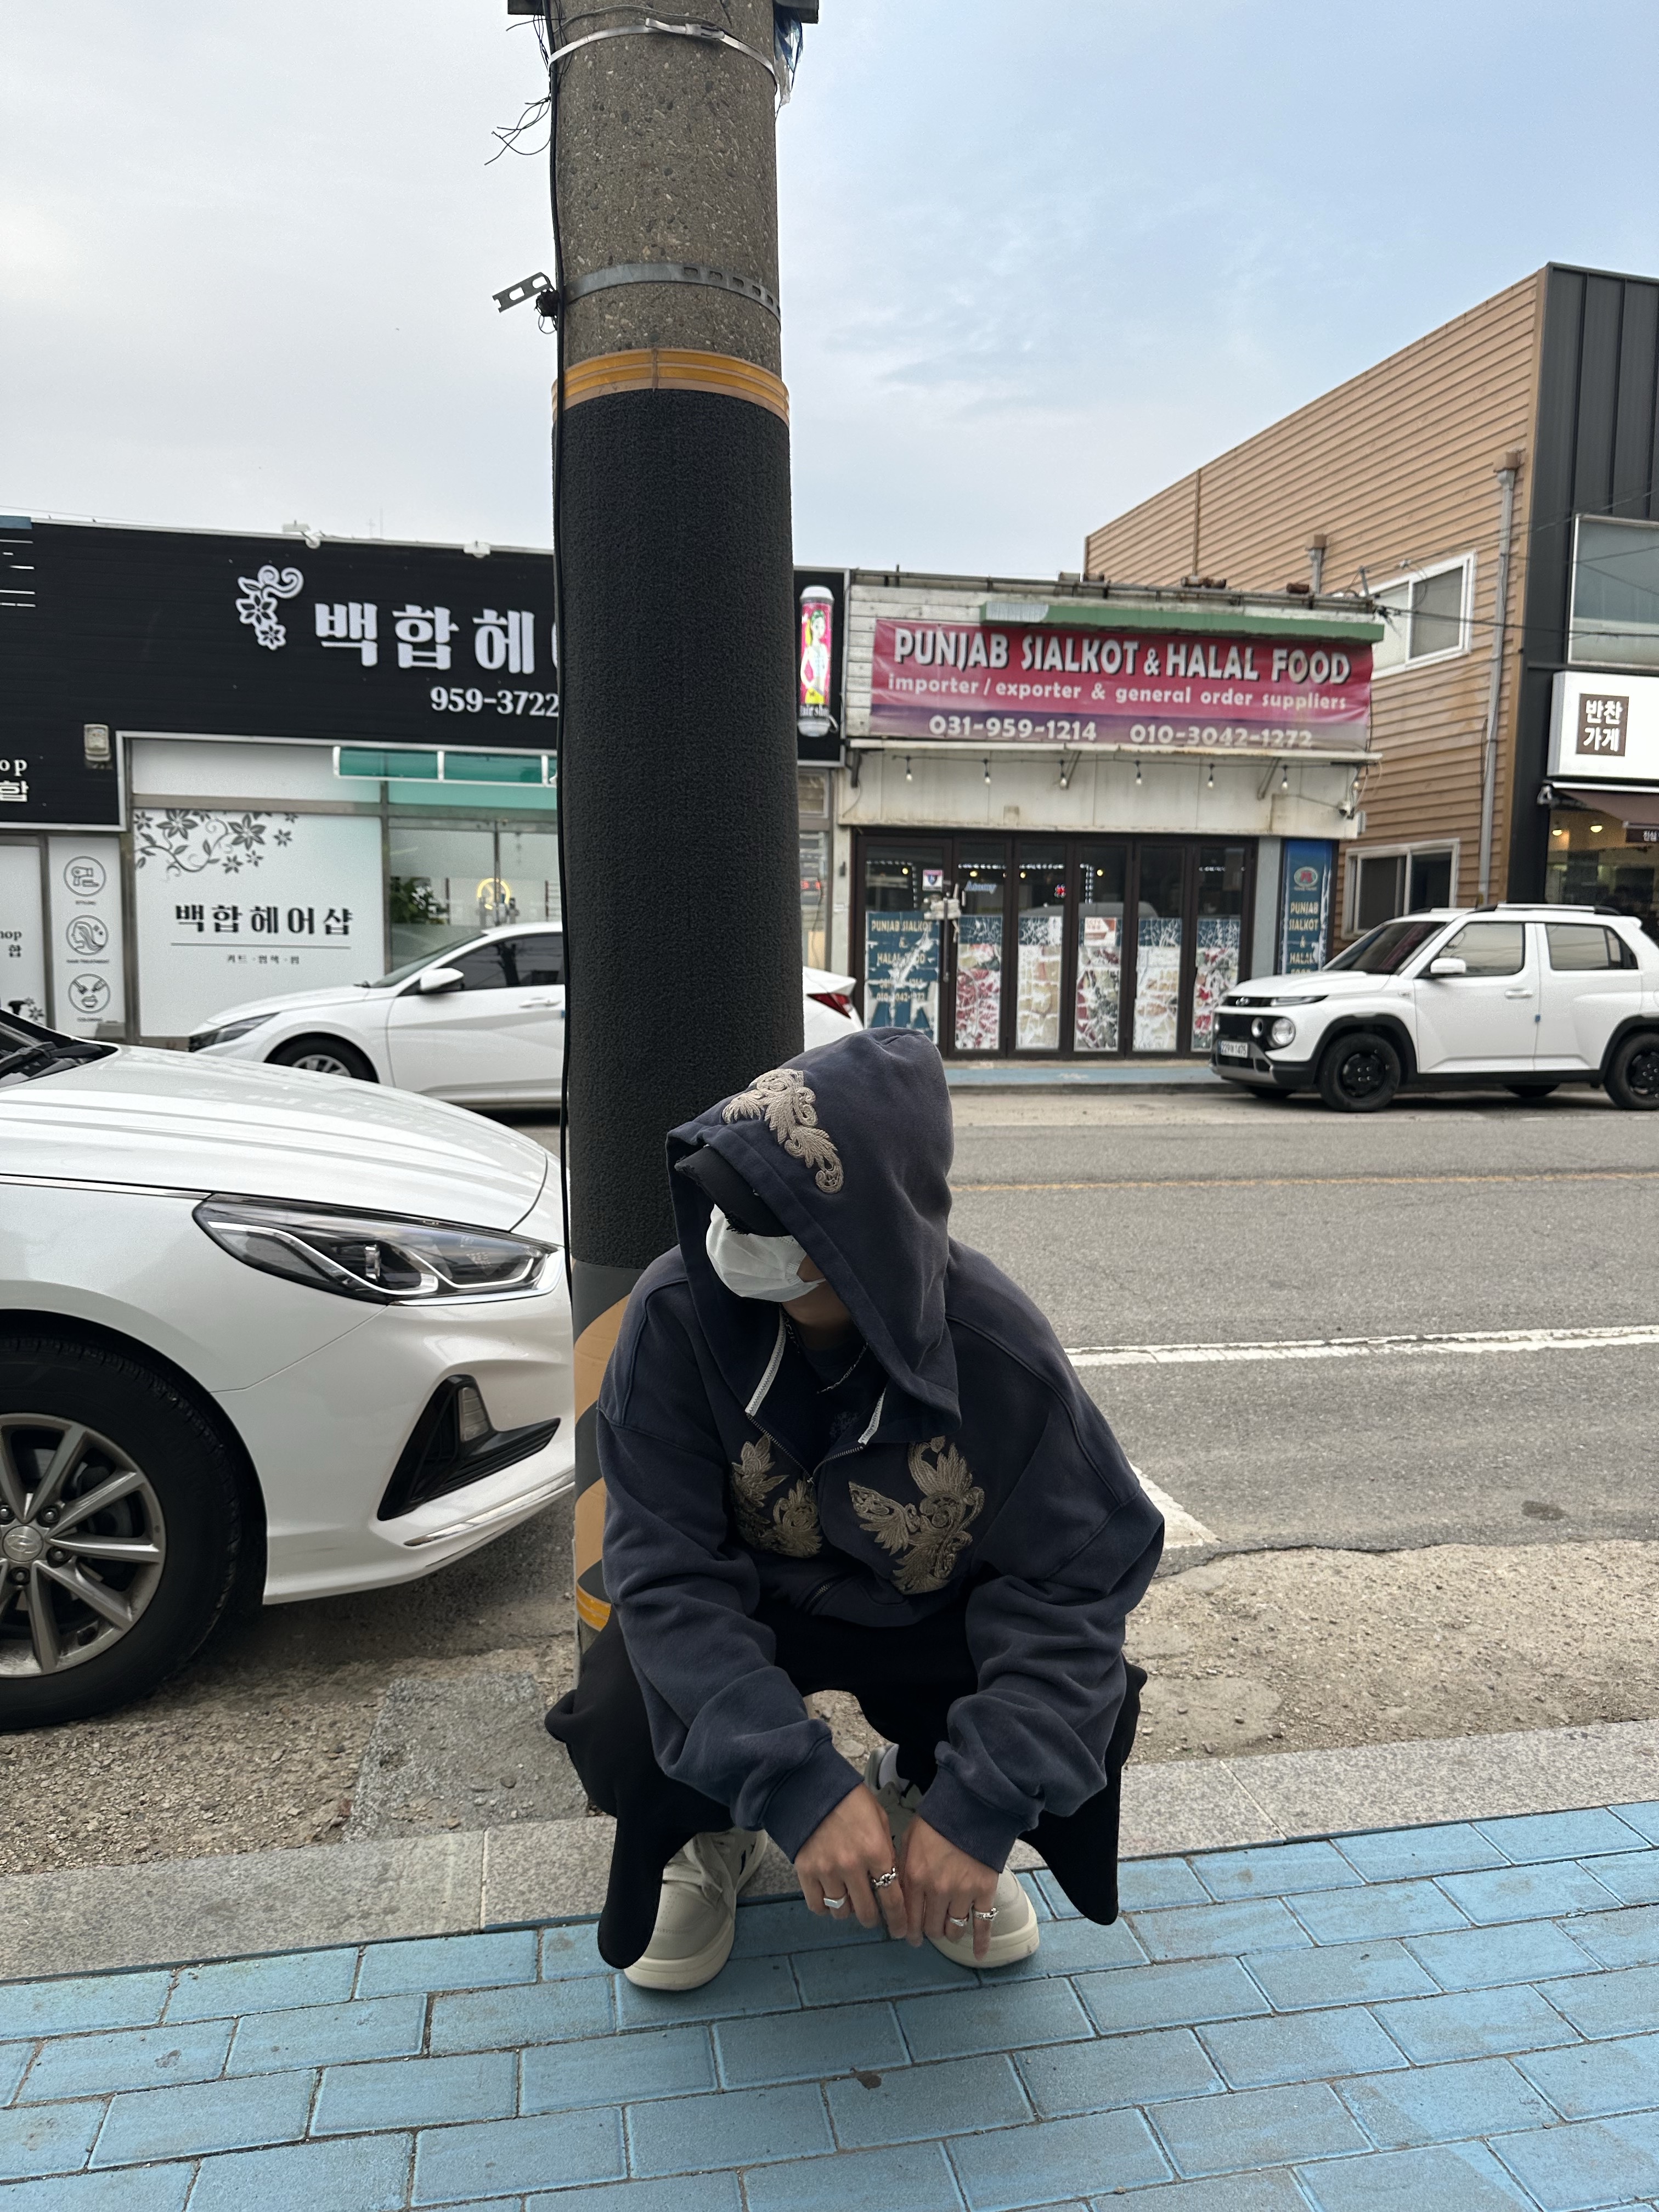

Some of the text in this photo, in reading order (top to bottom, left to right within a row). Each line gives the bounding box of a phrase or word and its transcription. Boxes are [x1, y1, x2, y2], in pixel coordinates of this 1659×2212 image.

[314, 602, 558, 674] 백합헤
[894, 627, 1352, 685] PUNJAB SIALKOT & HALAL FOOD
[430, 686, 558, 718] 959-3722
[888, 674, 979, 695] importer
[996, 681, 1081, 701] exporter
[1091, 682, 1107, 701] &
[1115, 687, 1190, 704] general
[1200, 689, 1253, 706] order
[1262, 692, 1347, 710] suppliers
[1585, 699, 1623, 725] 반찬
[929, 715, 1313, 748] 031-959-1214 010-3042-1272
[1583, 726, 1621, 752] 가게
[175, 904, 353, 935] 백합헤어샵
[1290, 901, 1319, 915] PUNJAB
[871, 920, 932, 932] PUNJAB SIALKOT
[1289, 918, 1319, 931] SIALKOT
